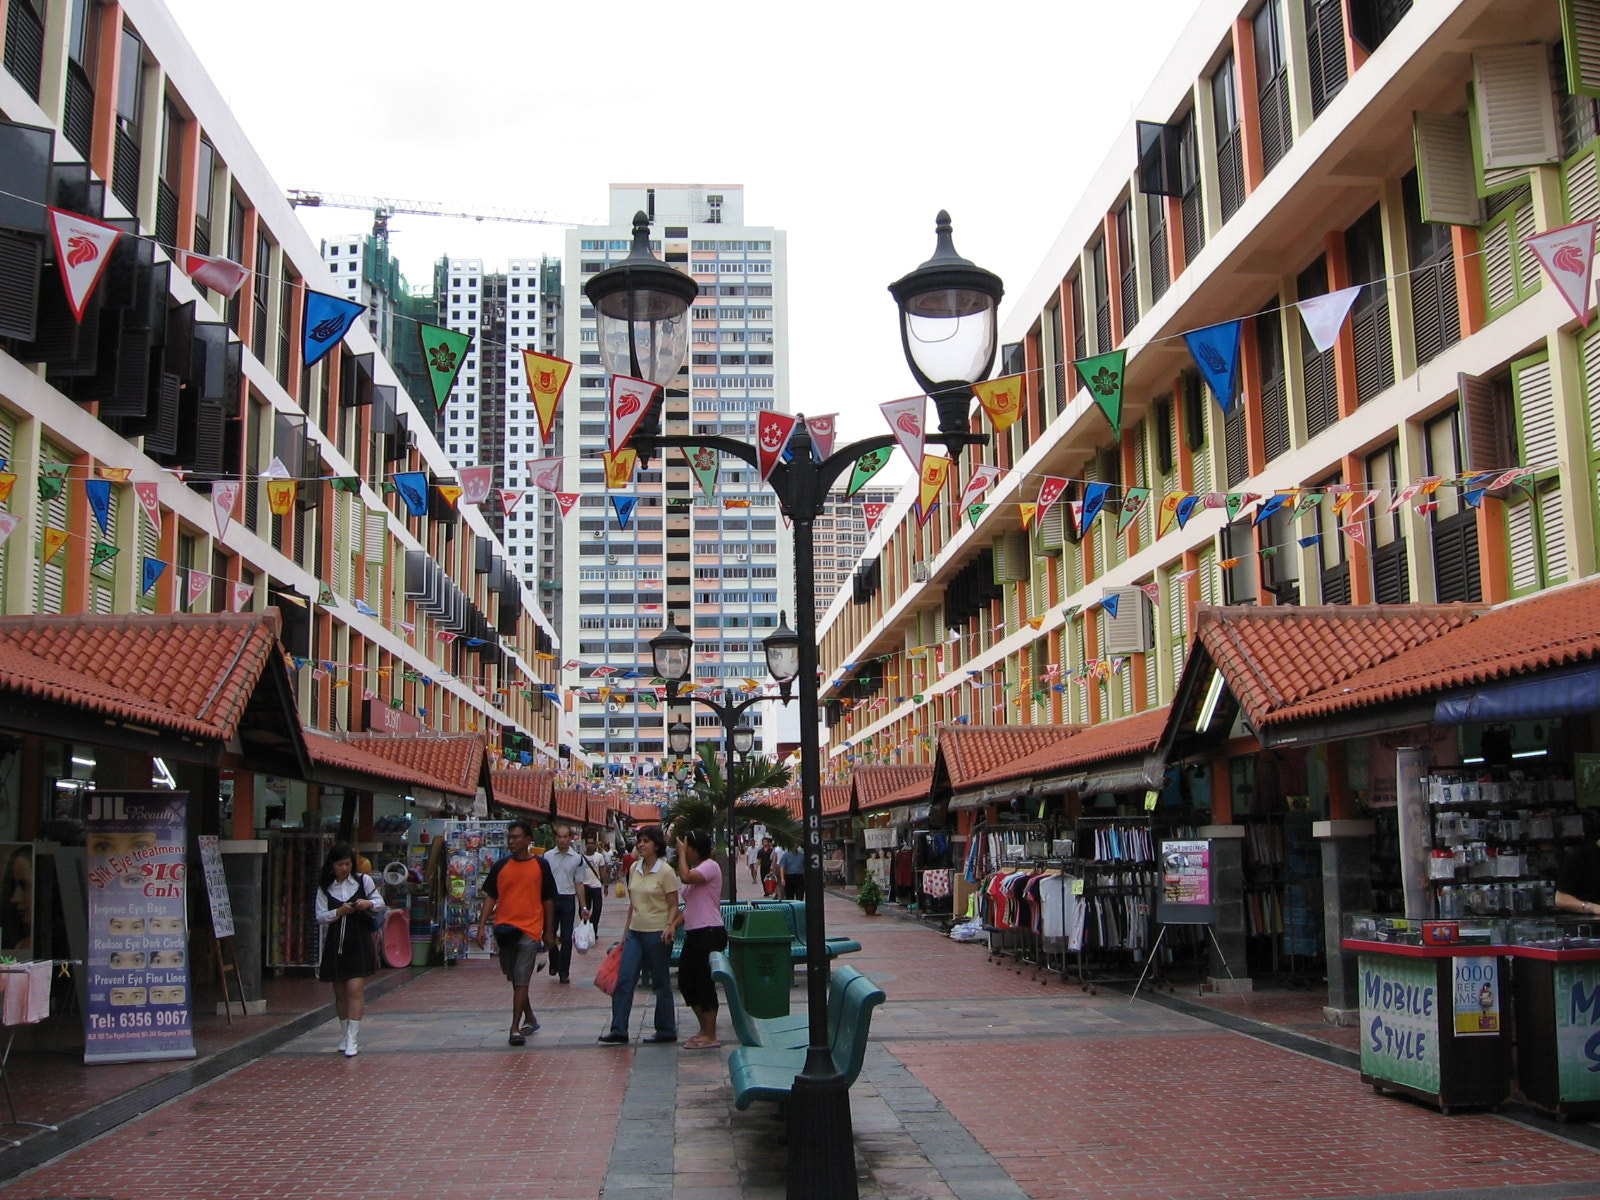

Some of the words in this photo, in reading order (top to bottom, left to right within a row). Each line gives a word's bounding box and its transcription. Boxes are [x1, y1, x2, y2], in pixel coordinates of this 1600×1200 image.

[88, 797, 128, 819] JIL
[126, 805, 178, 824] Beauty
[109, 857, 133, 873] Eye
[132, 846, 185, 861] treatment
[140, 861, 186, 881] $10
[143, 882, 183, 899] Only
[94, 939, 124, 950] Reduce
[125, 938, 140, 950] Eye
[142, 937, 161, 948] Dark
[163, 937, 185, 948] Circle
[94, 974, 126, 985] Prevent
[128, 973, 143, 986] Eye
[146, 972, 164, 983] Fine
[166, 972, 187, 983] Lines
[1364, 970, 1434, 1017] MOBILE
[90, 1013, 116, 1029] Tel:
[120, 1012, 152, 1027] 6356
[156, 1010, 188, 1025] 9067
[1370, 1015, 1426, 1061] STYLE
